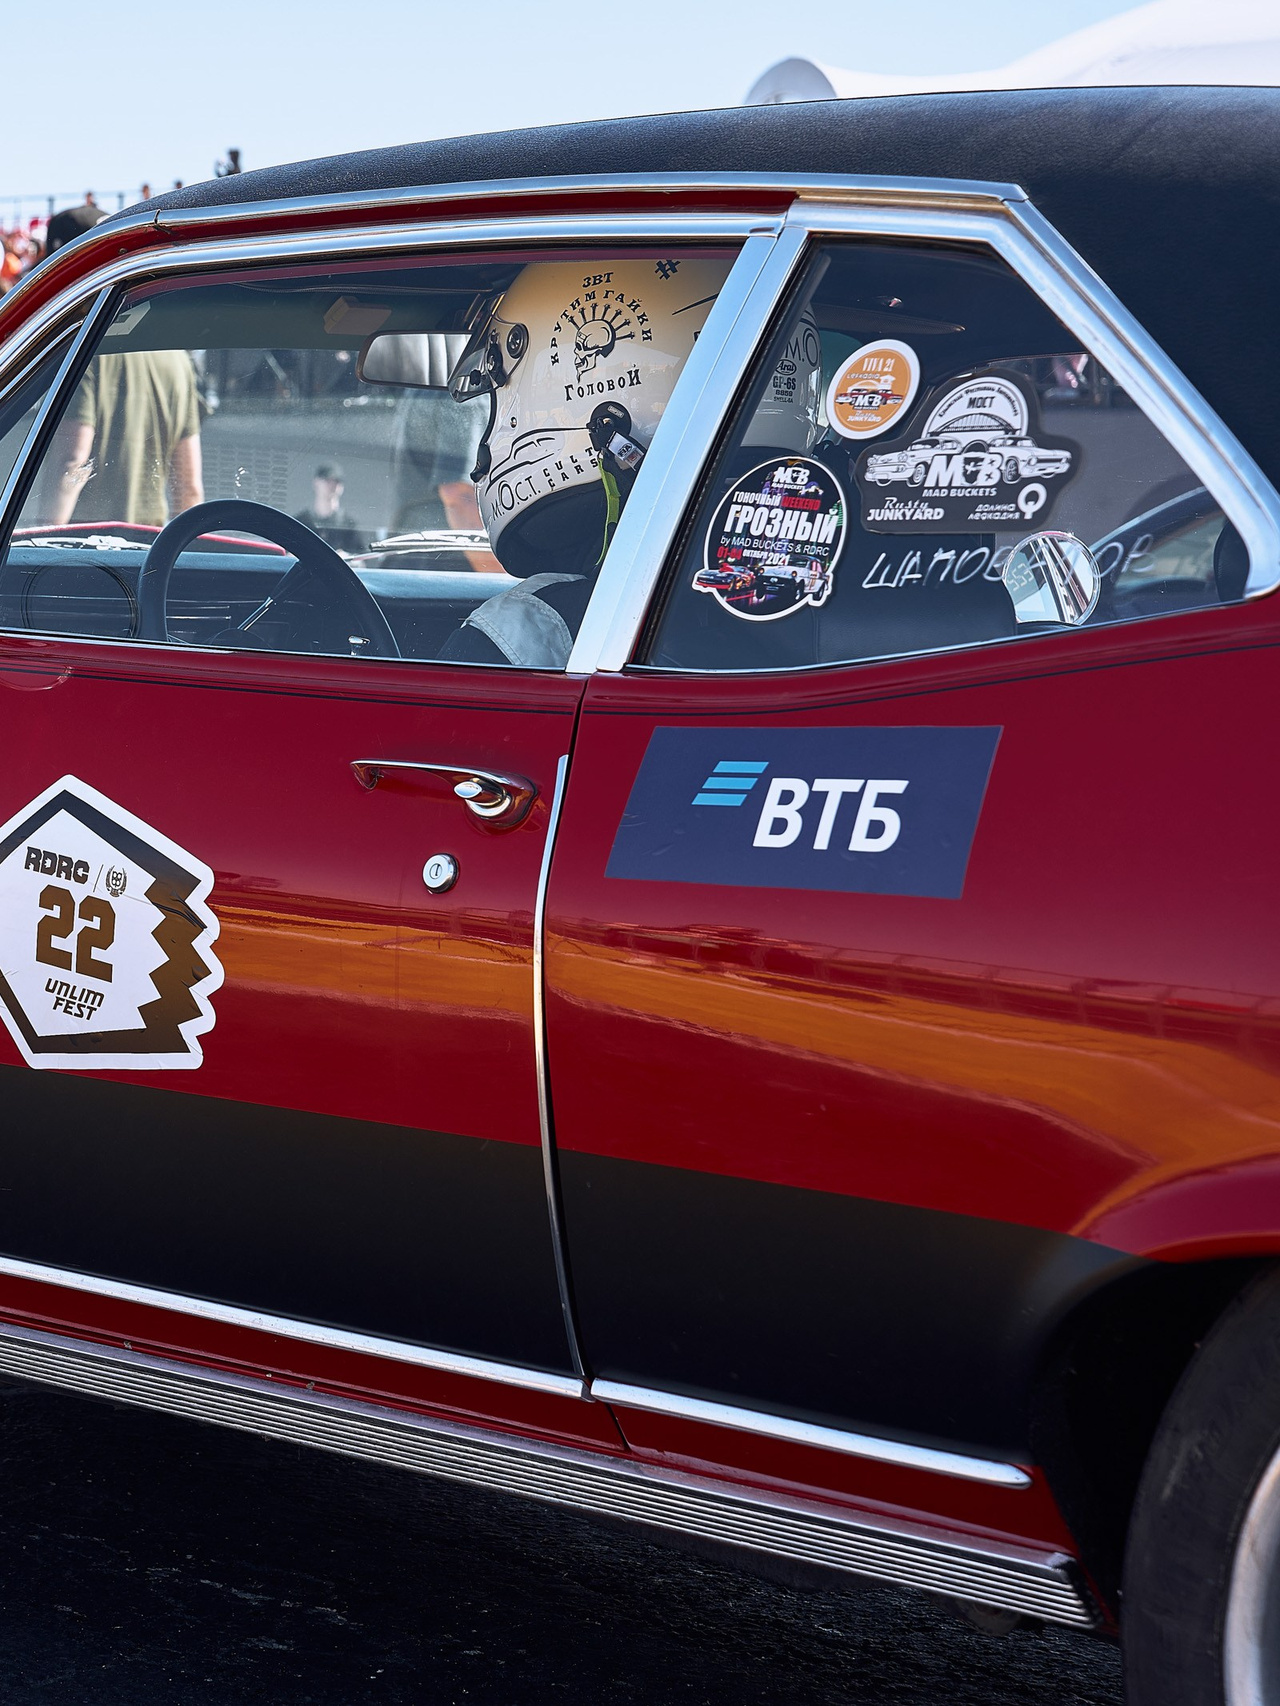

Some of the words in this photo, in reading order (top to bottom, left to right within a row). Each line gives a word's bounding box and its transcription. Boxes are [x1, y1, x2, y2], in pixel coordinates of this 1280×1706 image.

[582, 272, 614, 288] ЗВТ
[550, 290, 596, 366] КРУТИМ
[603, 289, 653, 342] ГАЙКИ
[863, 358, 884, 371] VIVA
[884, 358, 895, 371] 21
[773, 376, 797, 390] GP-6S
[542, 446, 594, 478] CULT
[547, 458, 599, 488] CARS
[732, 491, 782, 507] ГОНОЧНЫЙ
[782, 496, 821, 510] WEEKEND
[883, 497, 929, 510] Rusty
[922, 488, 949, 497] MAD
[949, 488, 997, 497] BUCKETS
[723, 504, 839, 544] ГРОЗНЫЙ
[866, 507, 945, 521] JUNKYARD
[720, 535, 731, 547] by
[731, 536, 751, 547] MAD
[753, 539, 794, 553] BUCKETS
[794, 543, 802, 553] &
[803, 544, 830, 557] RDRC
[766, 552, 791, 566] 2021
[752, 777, 910, 853] ВТБ
[24, 846, 90, 885] RDRC
[36, 884, 116, 983] 22
[45, 978, 105, 1007] UNLIM
[52, 996, 98, 1021] FEST
